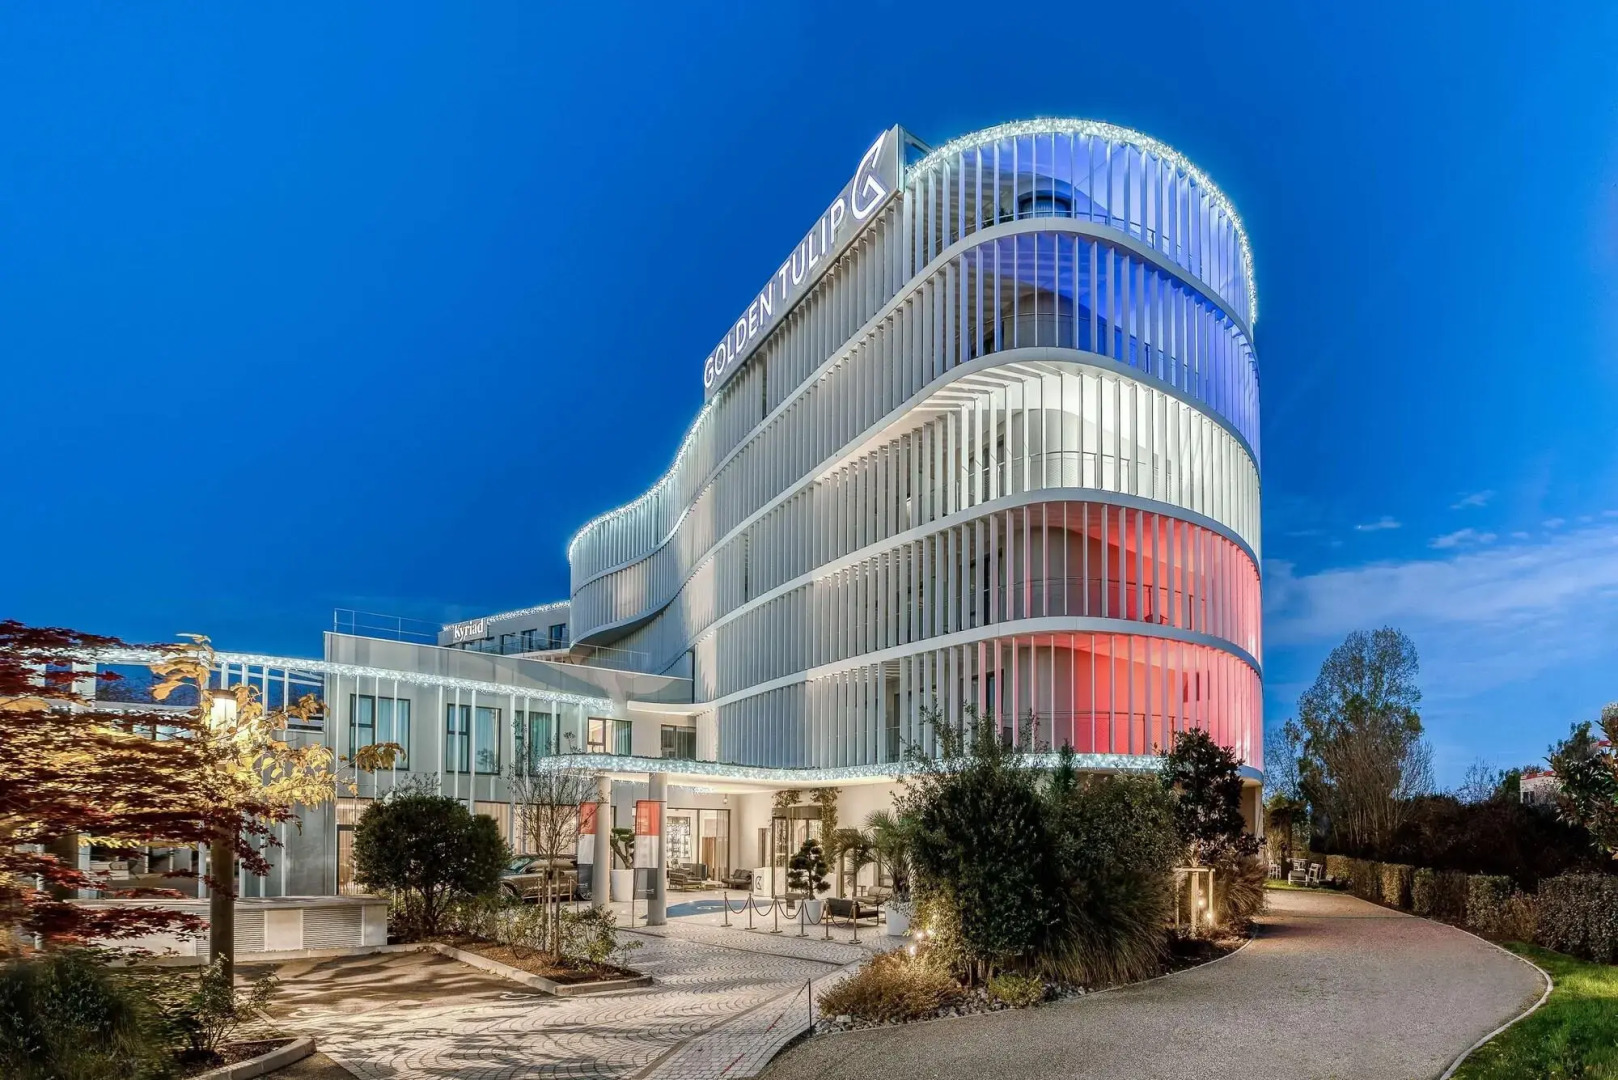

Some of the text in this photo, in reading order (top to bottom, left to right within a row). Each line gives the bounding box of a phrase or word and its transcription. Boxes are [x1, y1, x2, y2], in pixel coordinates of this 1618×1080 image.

[704, 282, 773, 388] GOLDEN
[778, 198, 845, 299] TULIP
[454, 618, 484, 641] Kyriad
